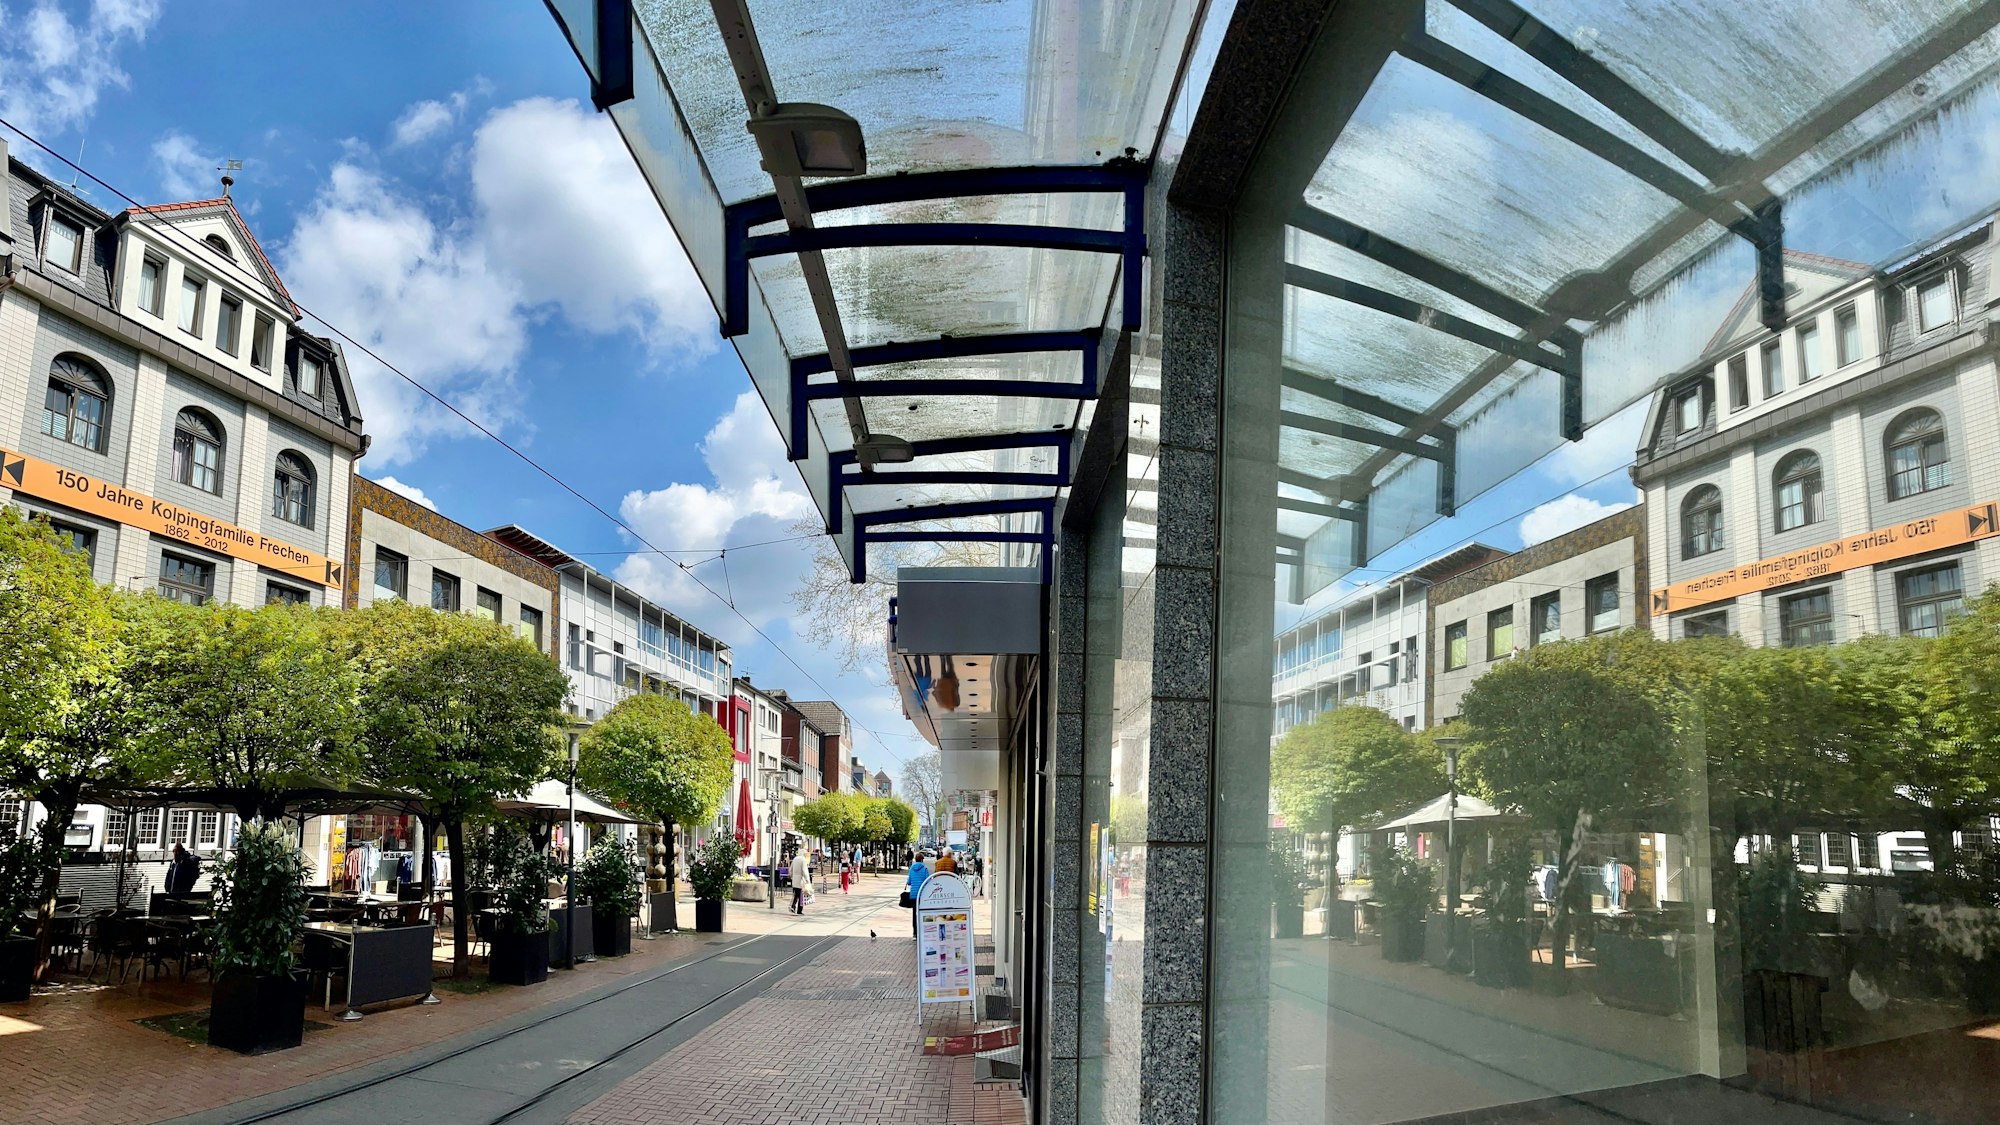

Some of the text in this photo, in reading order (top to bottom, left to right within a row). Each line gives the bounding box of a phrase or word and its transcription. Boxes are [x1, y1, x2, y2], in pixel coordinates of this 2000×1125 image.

[56, 469, 310, 565] 150 Jahre Kolpingfamilie Frechen
[164, 523, 190, 541] 1862
[204, 536, 228, 552] 2012
